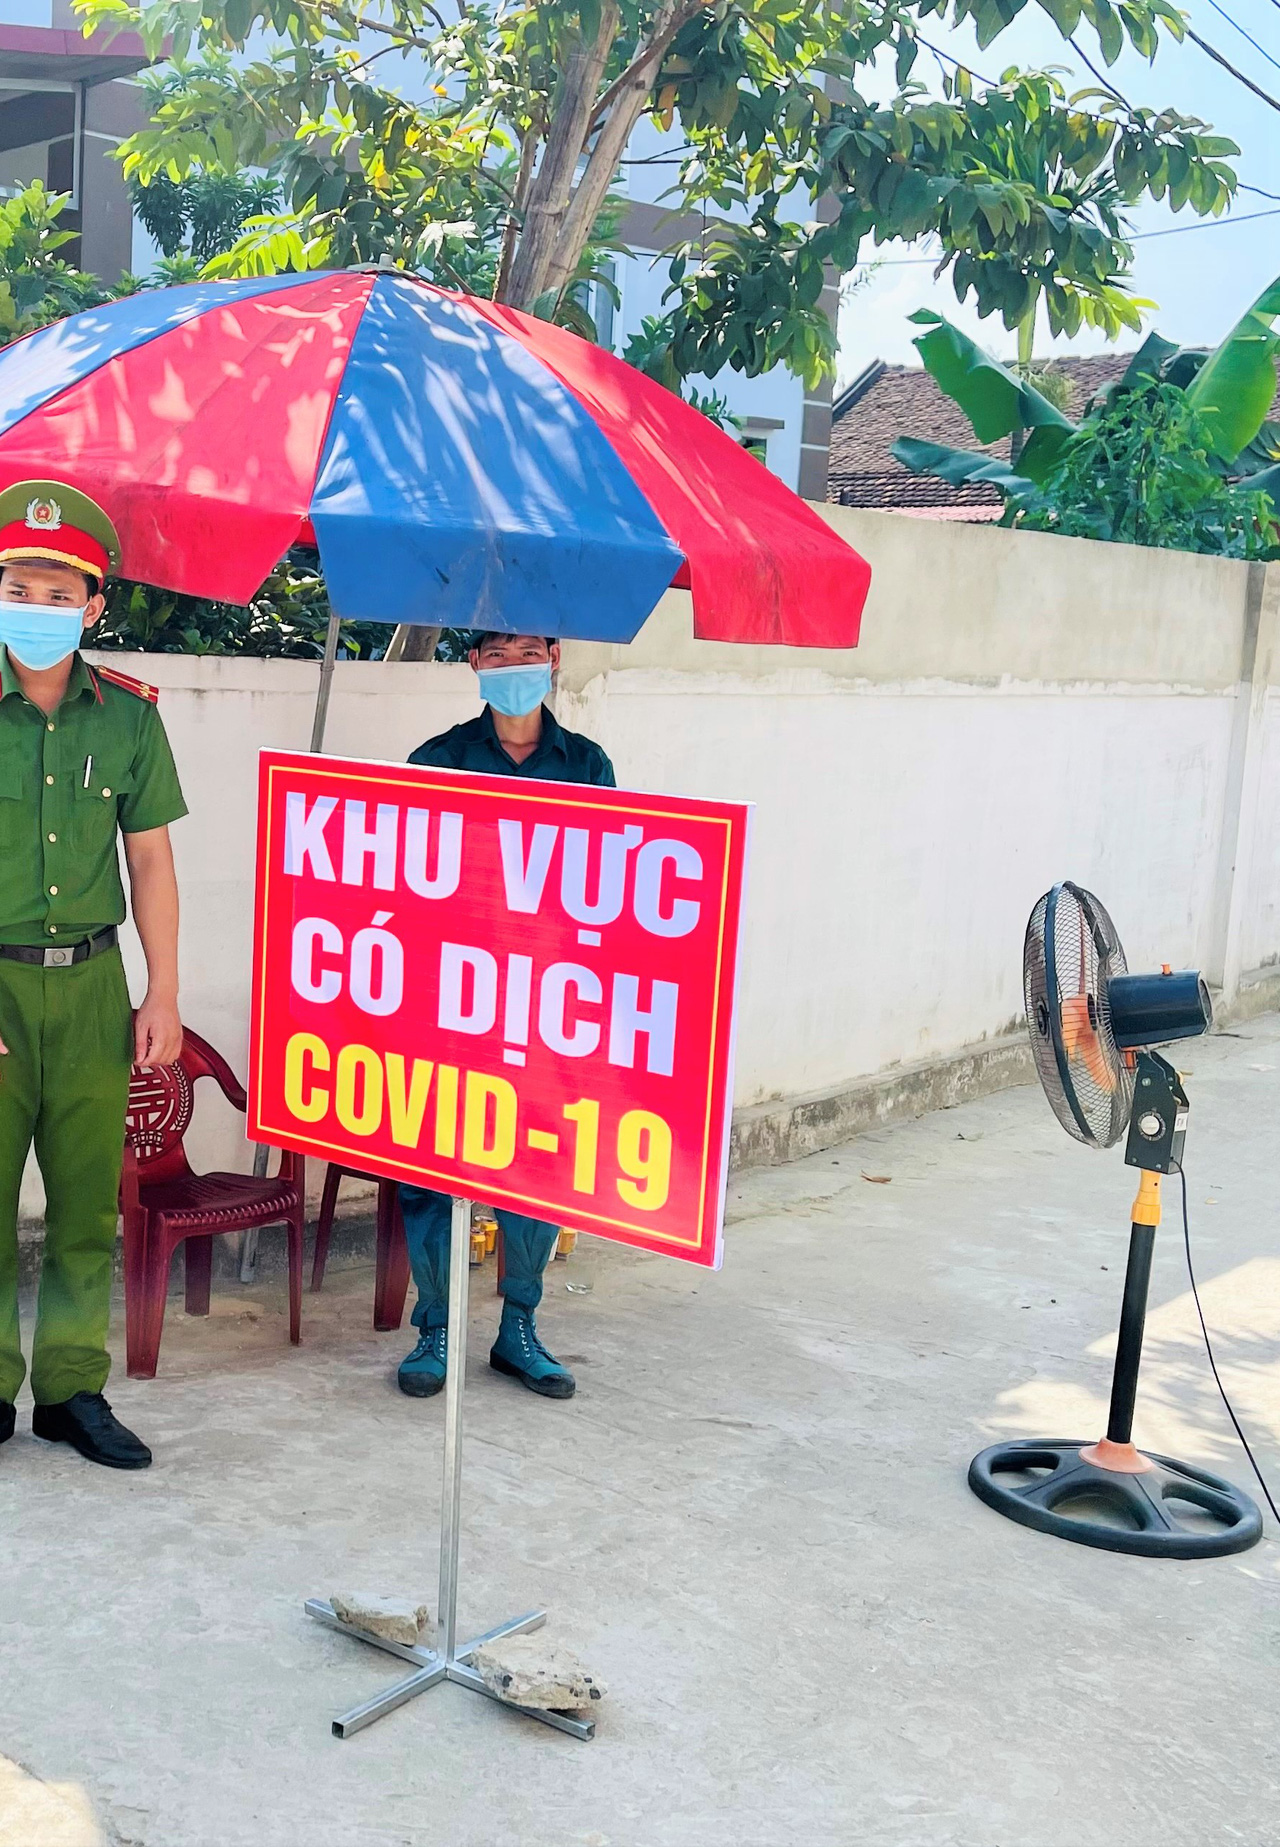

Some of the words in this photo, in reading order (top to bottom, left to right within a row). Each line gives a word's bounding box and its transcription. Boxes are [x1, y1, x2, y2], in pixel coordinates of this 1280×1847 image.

[283, 791, 464, 900] KHU
[498, 819, 704, 947] VỰC
[290, 912, 404, 1017] CÓ
[437, 941, 680, 1078] DỊCH
[284, 1032, 673, 1212] COVID-19
